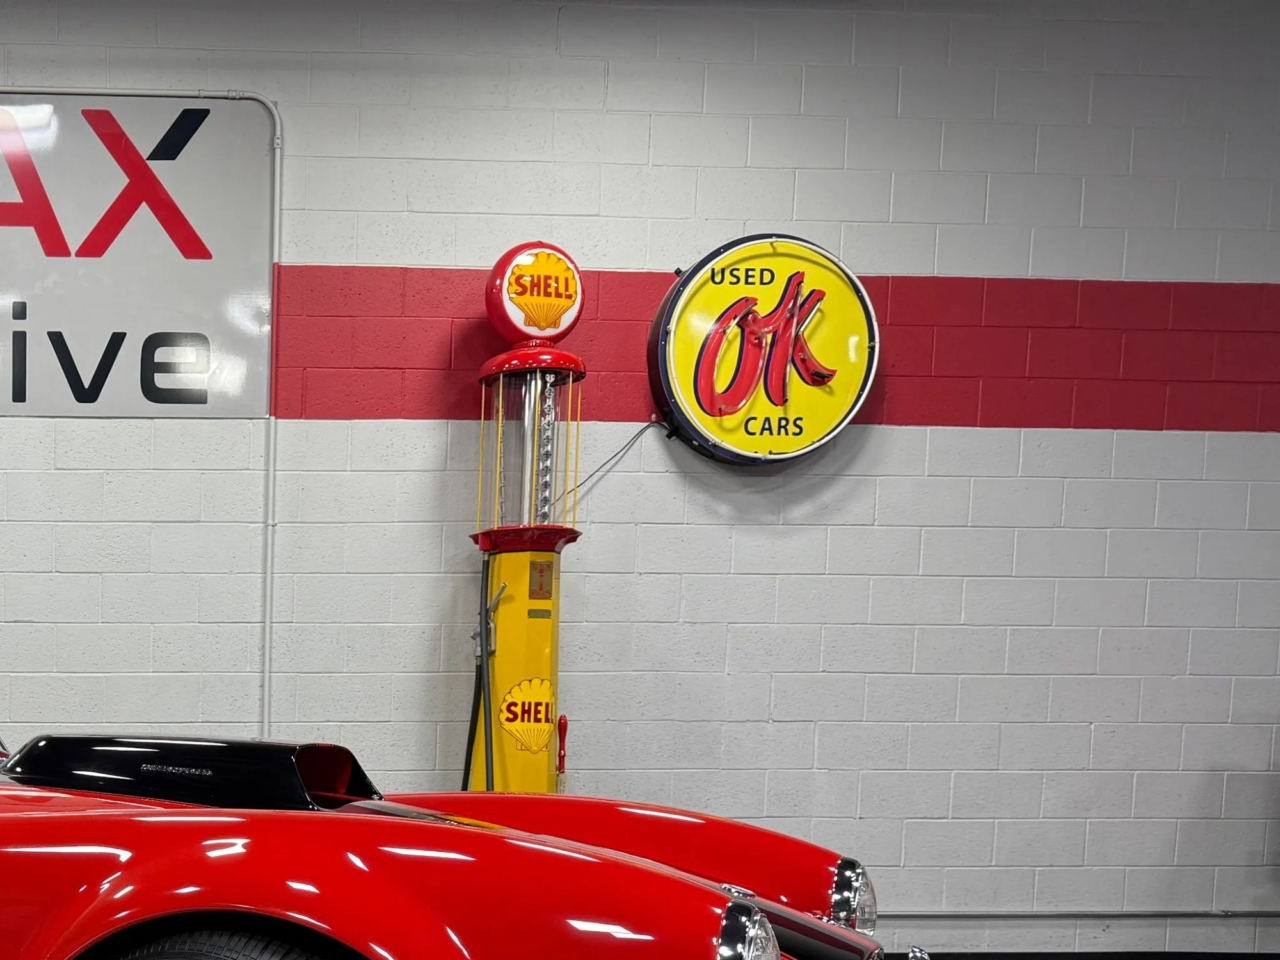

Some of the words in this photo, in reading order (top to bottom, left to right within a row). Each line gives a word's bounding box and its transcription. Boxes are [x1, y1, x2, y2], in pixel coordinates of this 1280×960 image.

[513, 274, 573, 300] SHELL
[710, 268, 775, 286] USED
[693, 271, 837, 417] OK
[744, 416, 804, 436] CARS
